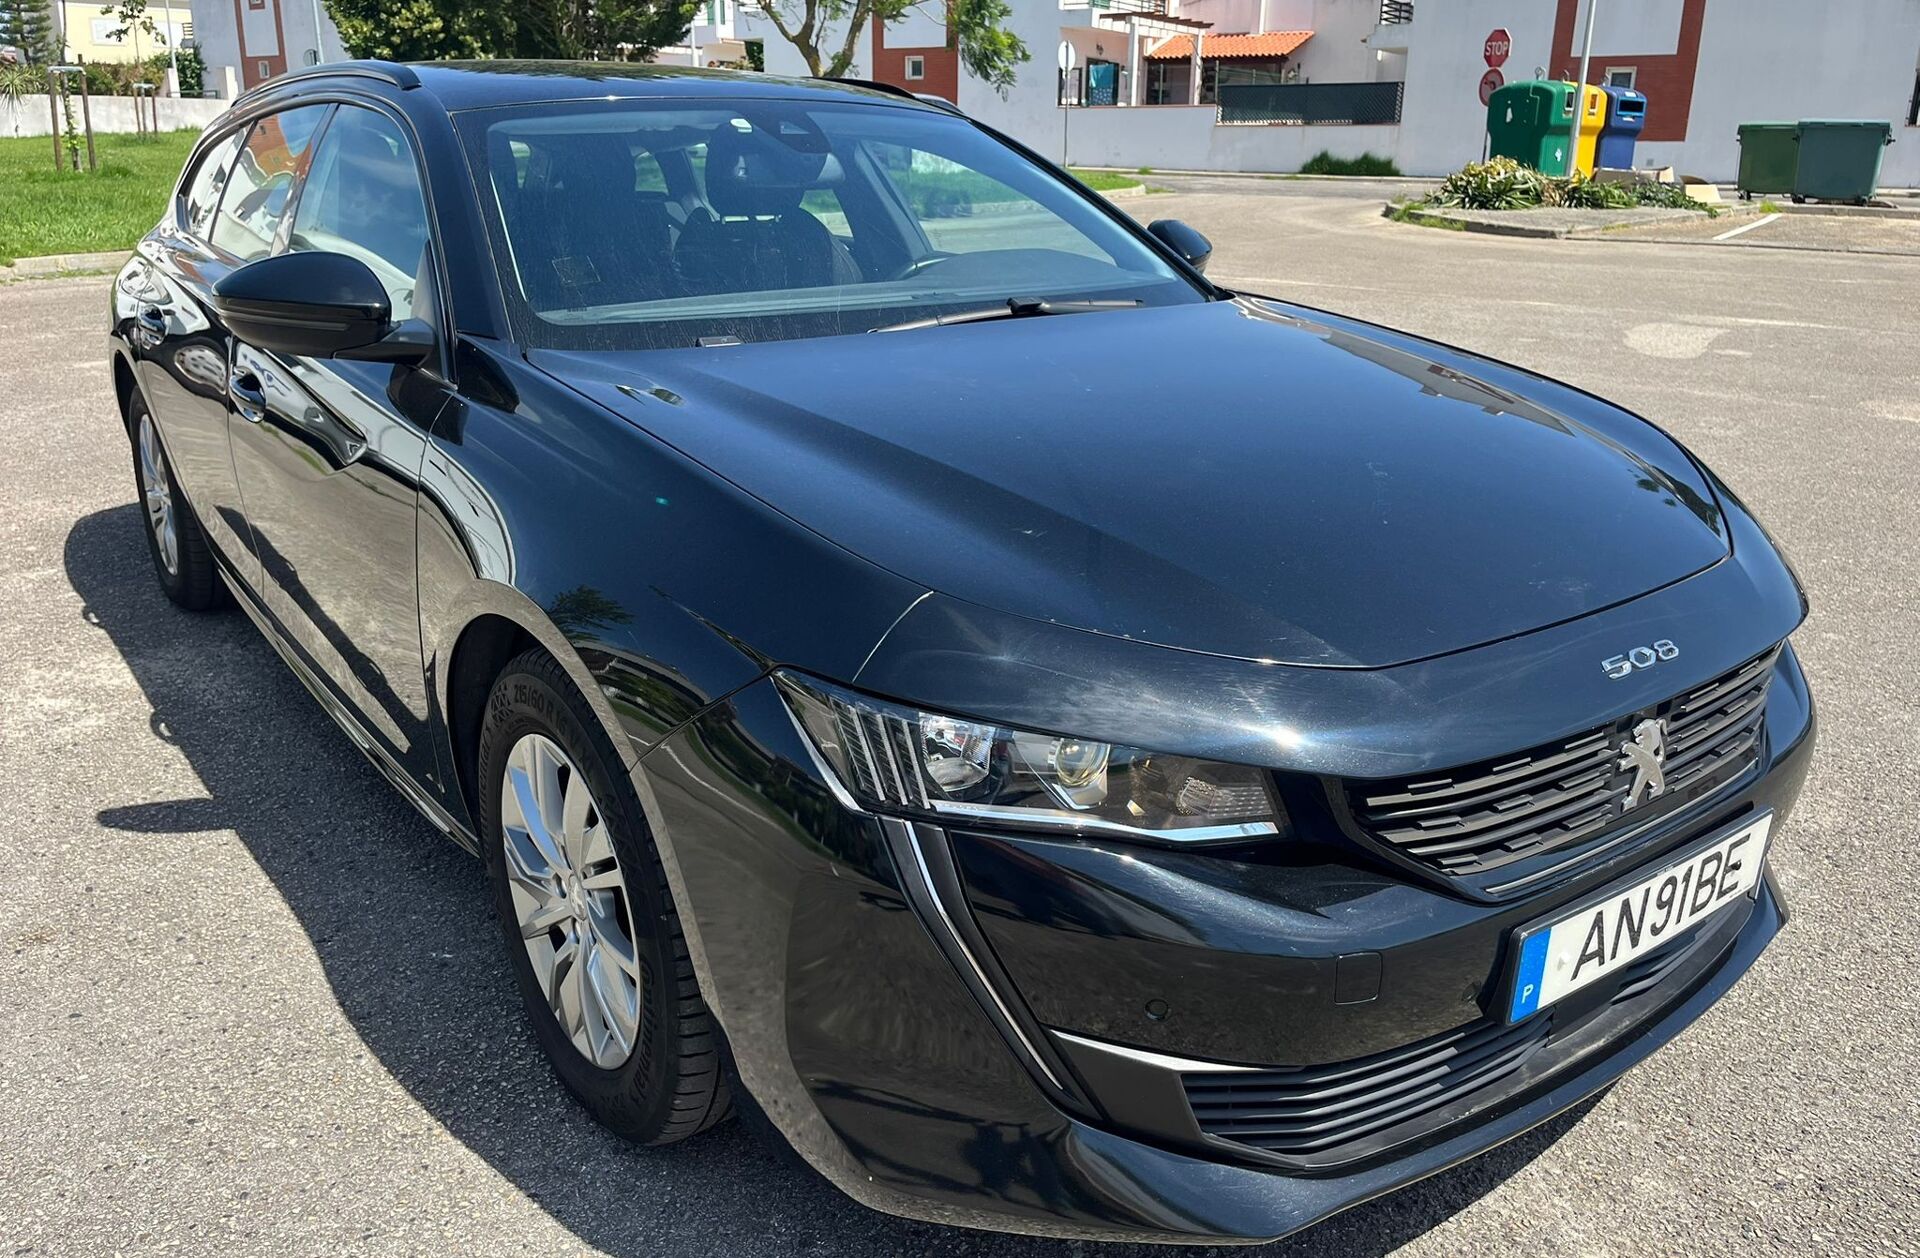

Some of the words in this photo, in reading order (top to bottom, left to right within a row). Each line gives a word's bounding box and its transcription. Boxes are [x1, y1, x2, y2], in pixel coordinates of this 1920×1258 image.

[1485, 41, 1509, 55] STOP
[1601, 639, 1679, 679] 508
[1570, 833, 1751, 981] AN91BE
[1522, 983, 1534, 1003] P
